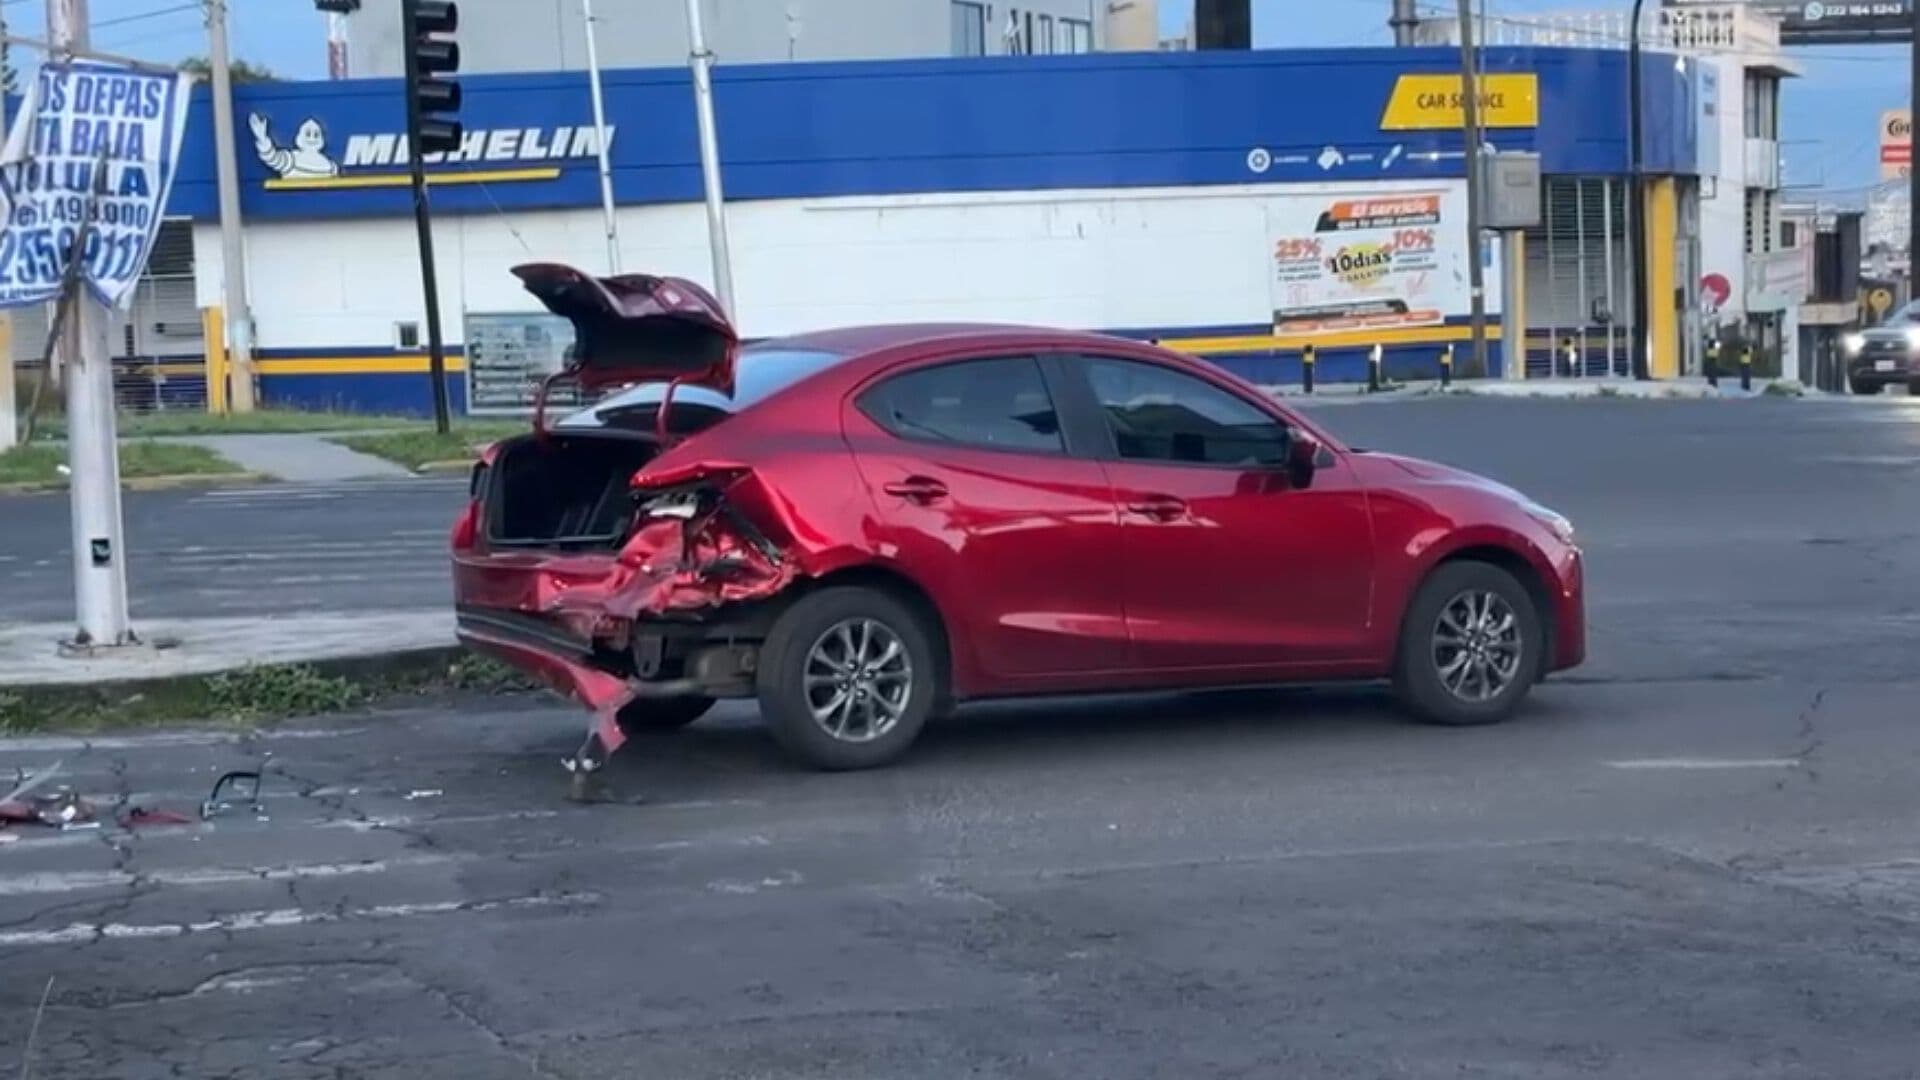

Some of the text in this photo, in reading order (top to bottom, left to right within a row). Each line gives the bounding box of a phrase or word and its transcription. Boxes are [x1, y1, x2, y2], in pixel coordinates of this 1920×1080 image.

[73, 75, 162, 119] DEPAS
[1416, 92, 1505, 110] CAR SEICE
[70, 118, 145, 160] BAJA
[343, 125, 615, 167] MIHELIN
